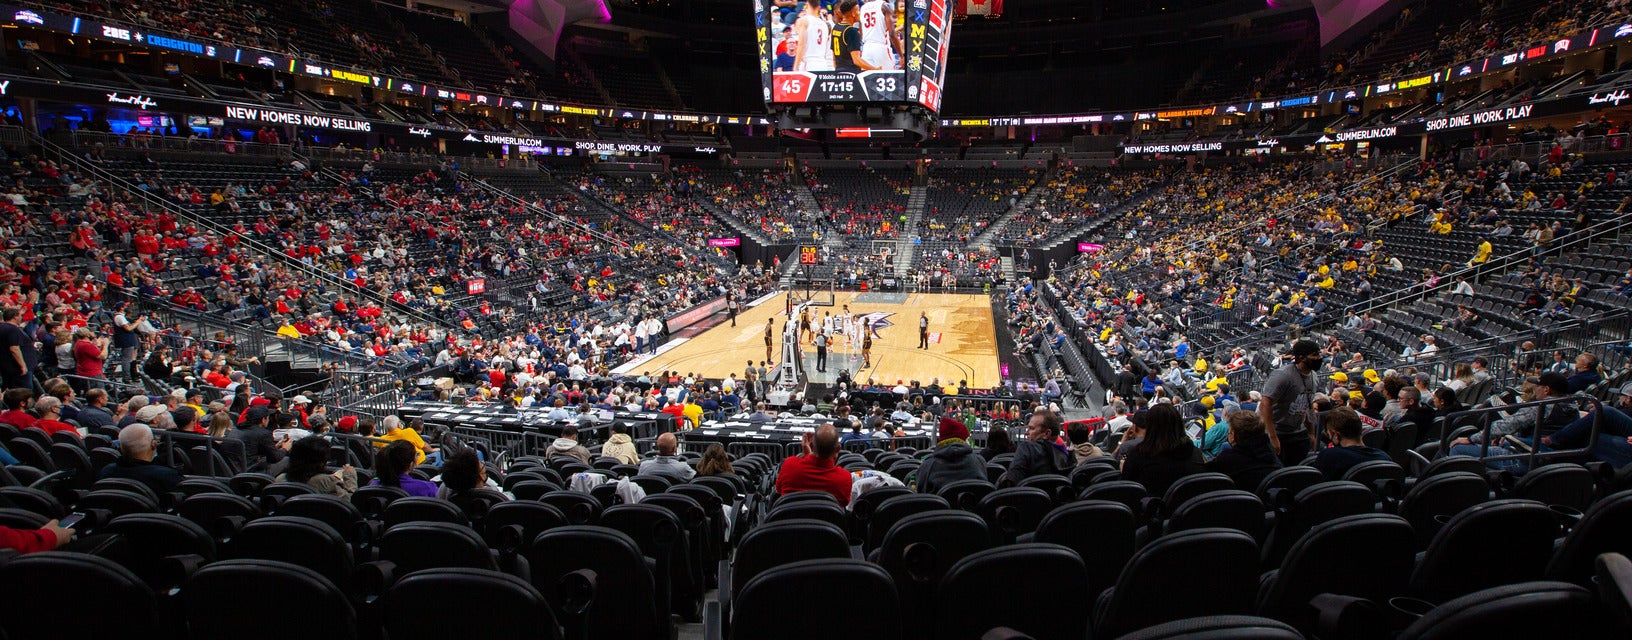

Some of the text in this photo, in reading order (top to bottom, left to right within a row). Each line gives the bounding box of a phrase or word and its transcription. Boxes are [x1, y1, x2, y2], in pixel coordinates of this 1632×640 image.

[863, 11, 877, 29] 35
[910, 23, 925, 39] M
[102, 25, 203, 54] 2015 CREIGHTON
[331, 69, 370, 84] VALPARAISO
[1398, 75, 1432, 90] VALPARAISO
[782, 80, 801, 94] 45
[820, 81, 854, 92] 17:15
[876, 77, 896, 92] 33
[1281, 96, 1310, 107] CREIGHTON
[226, 106, 371, 132] NEW HOMES NOW SELLING
[1157, 110, 1186, 119] OKLAHOMA
[1187, 109, 1203, 117] STATE
[1426, 104, 1533, 131] SHOP. DINE. WORK. PLAY
[483, 134, 542, 147] SUMMERLIN.COM
[1336, 126, 1397, 141] SUMMERLIN.COM
[575, 141, 596, 149] SHOP.
[597, 142, 616, 150] DINE.
[617, 143, 642, 152] WORK.
[1124, 142, 1221, 154] NEW HOMES NOW SELLING
[801, 252, 815, 263] 30
